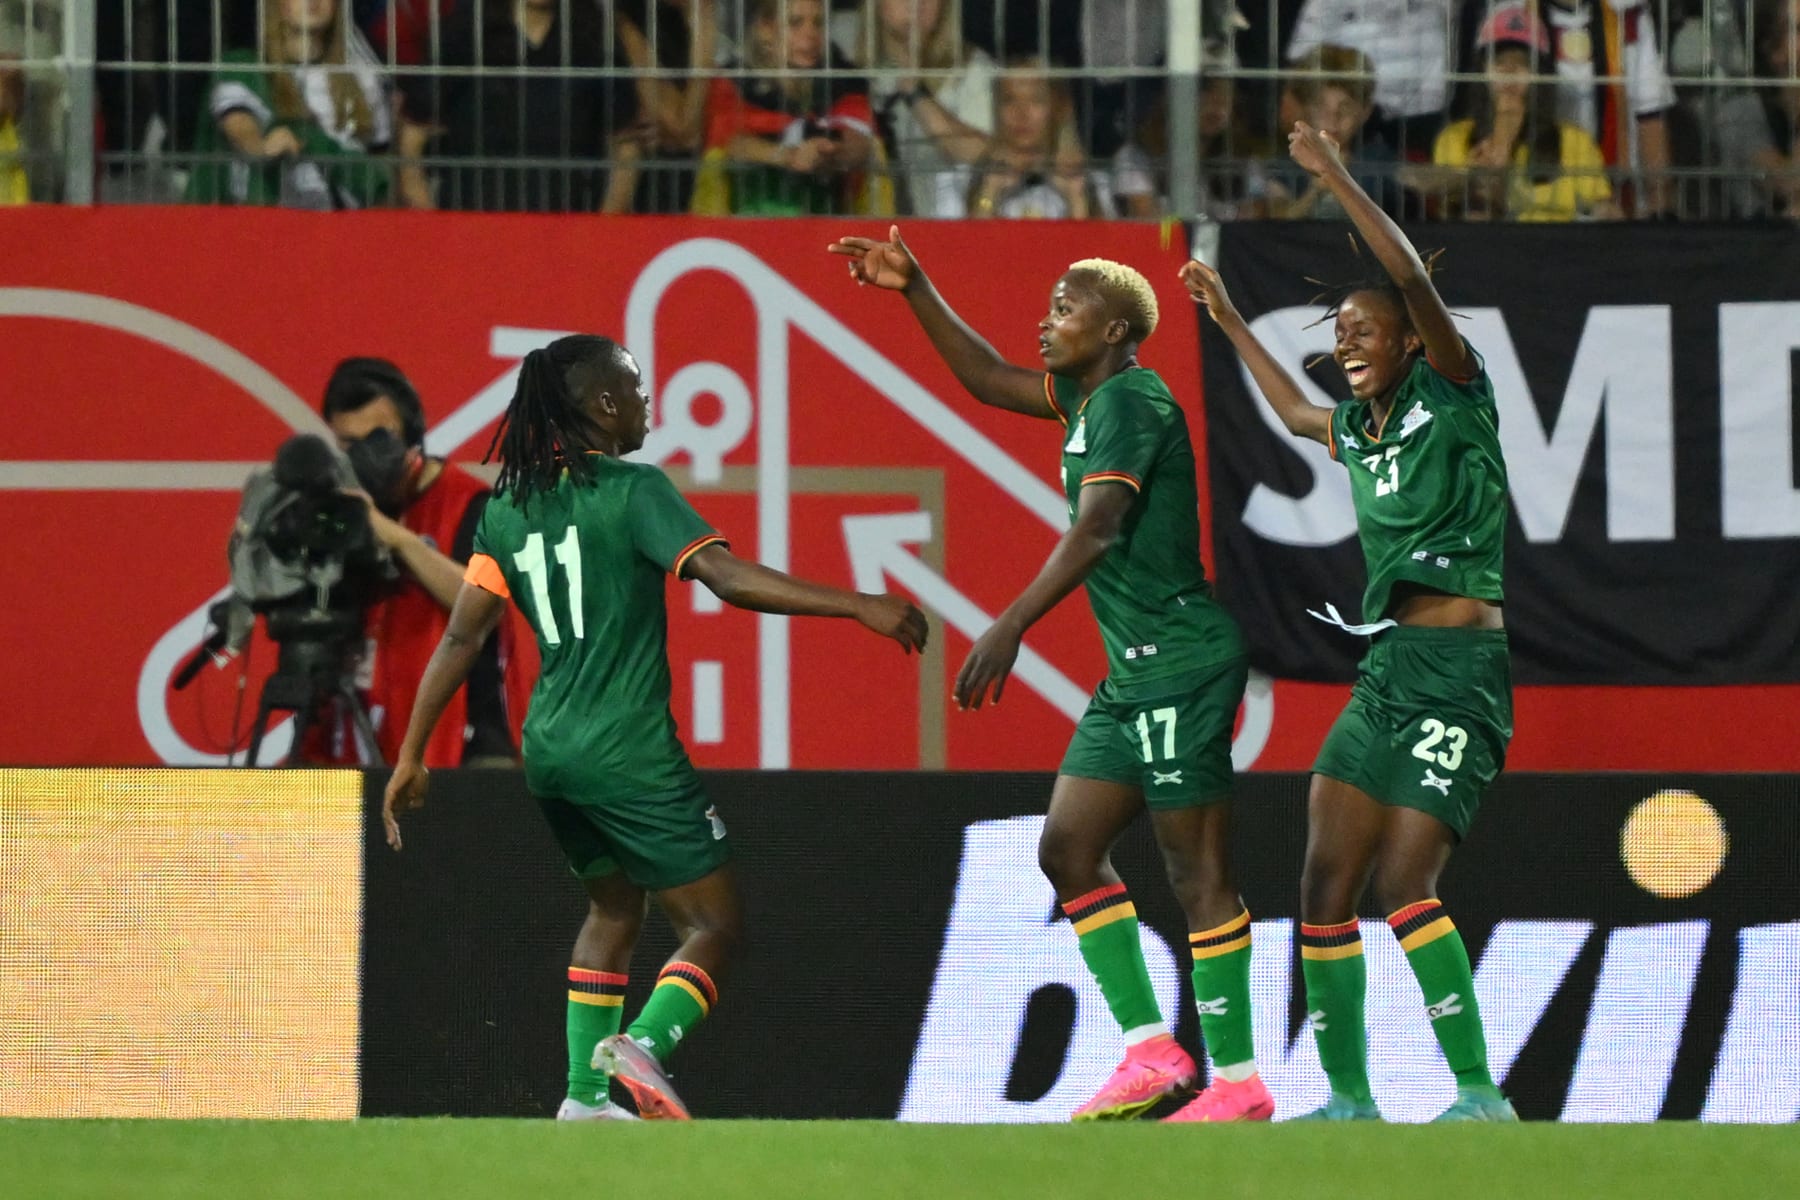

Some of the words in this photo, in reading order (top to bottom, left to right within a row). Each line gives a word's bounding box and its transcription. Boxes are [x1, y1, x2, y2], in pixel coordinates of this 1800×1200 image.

[513, 525, 584, 644] 11
[1136, 706, 1177, 763] 17
[1412, 718, 1468, 771] 23
